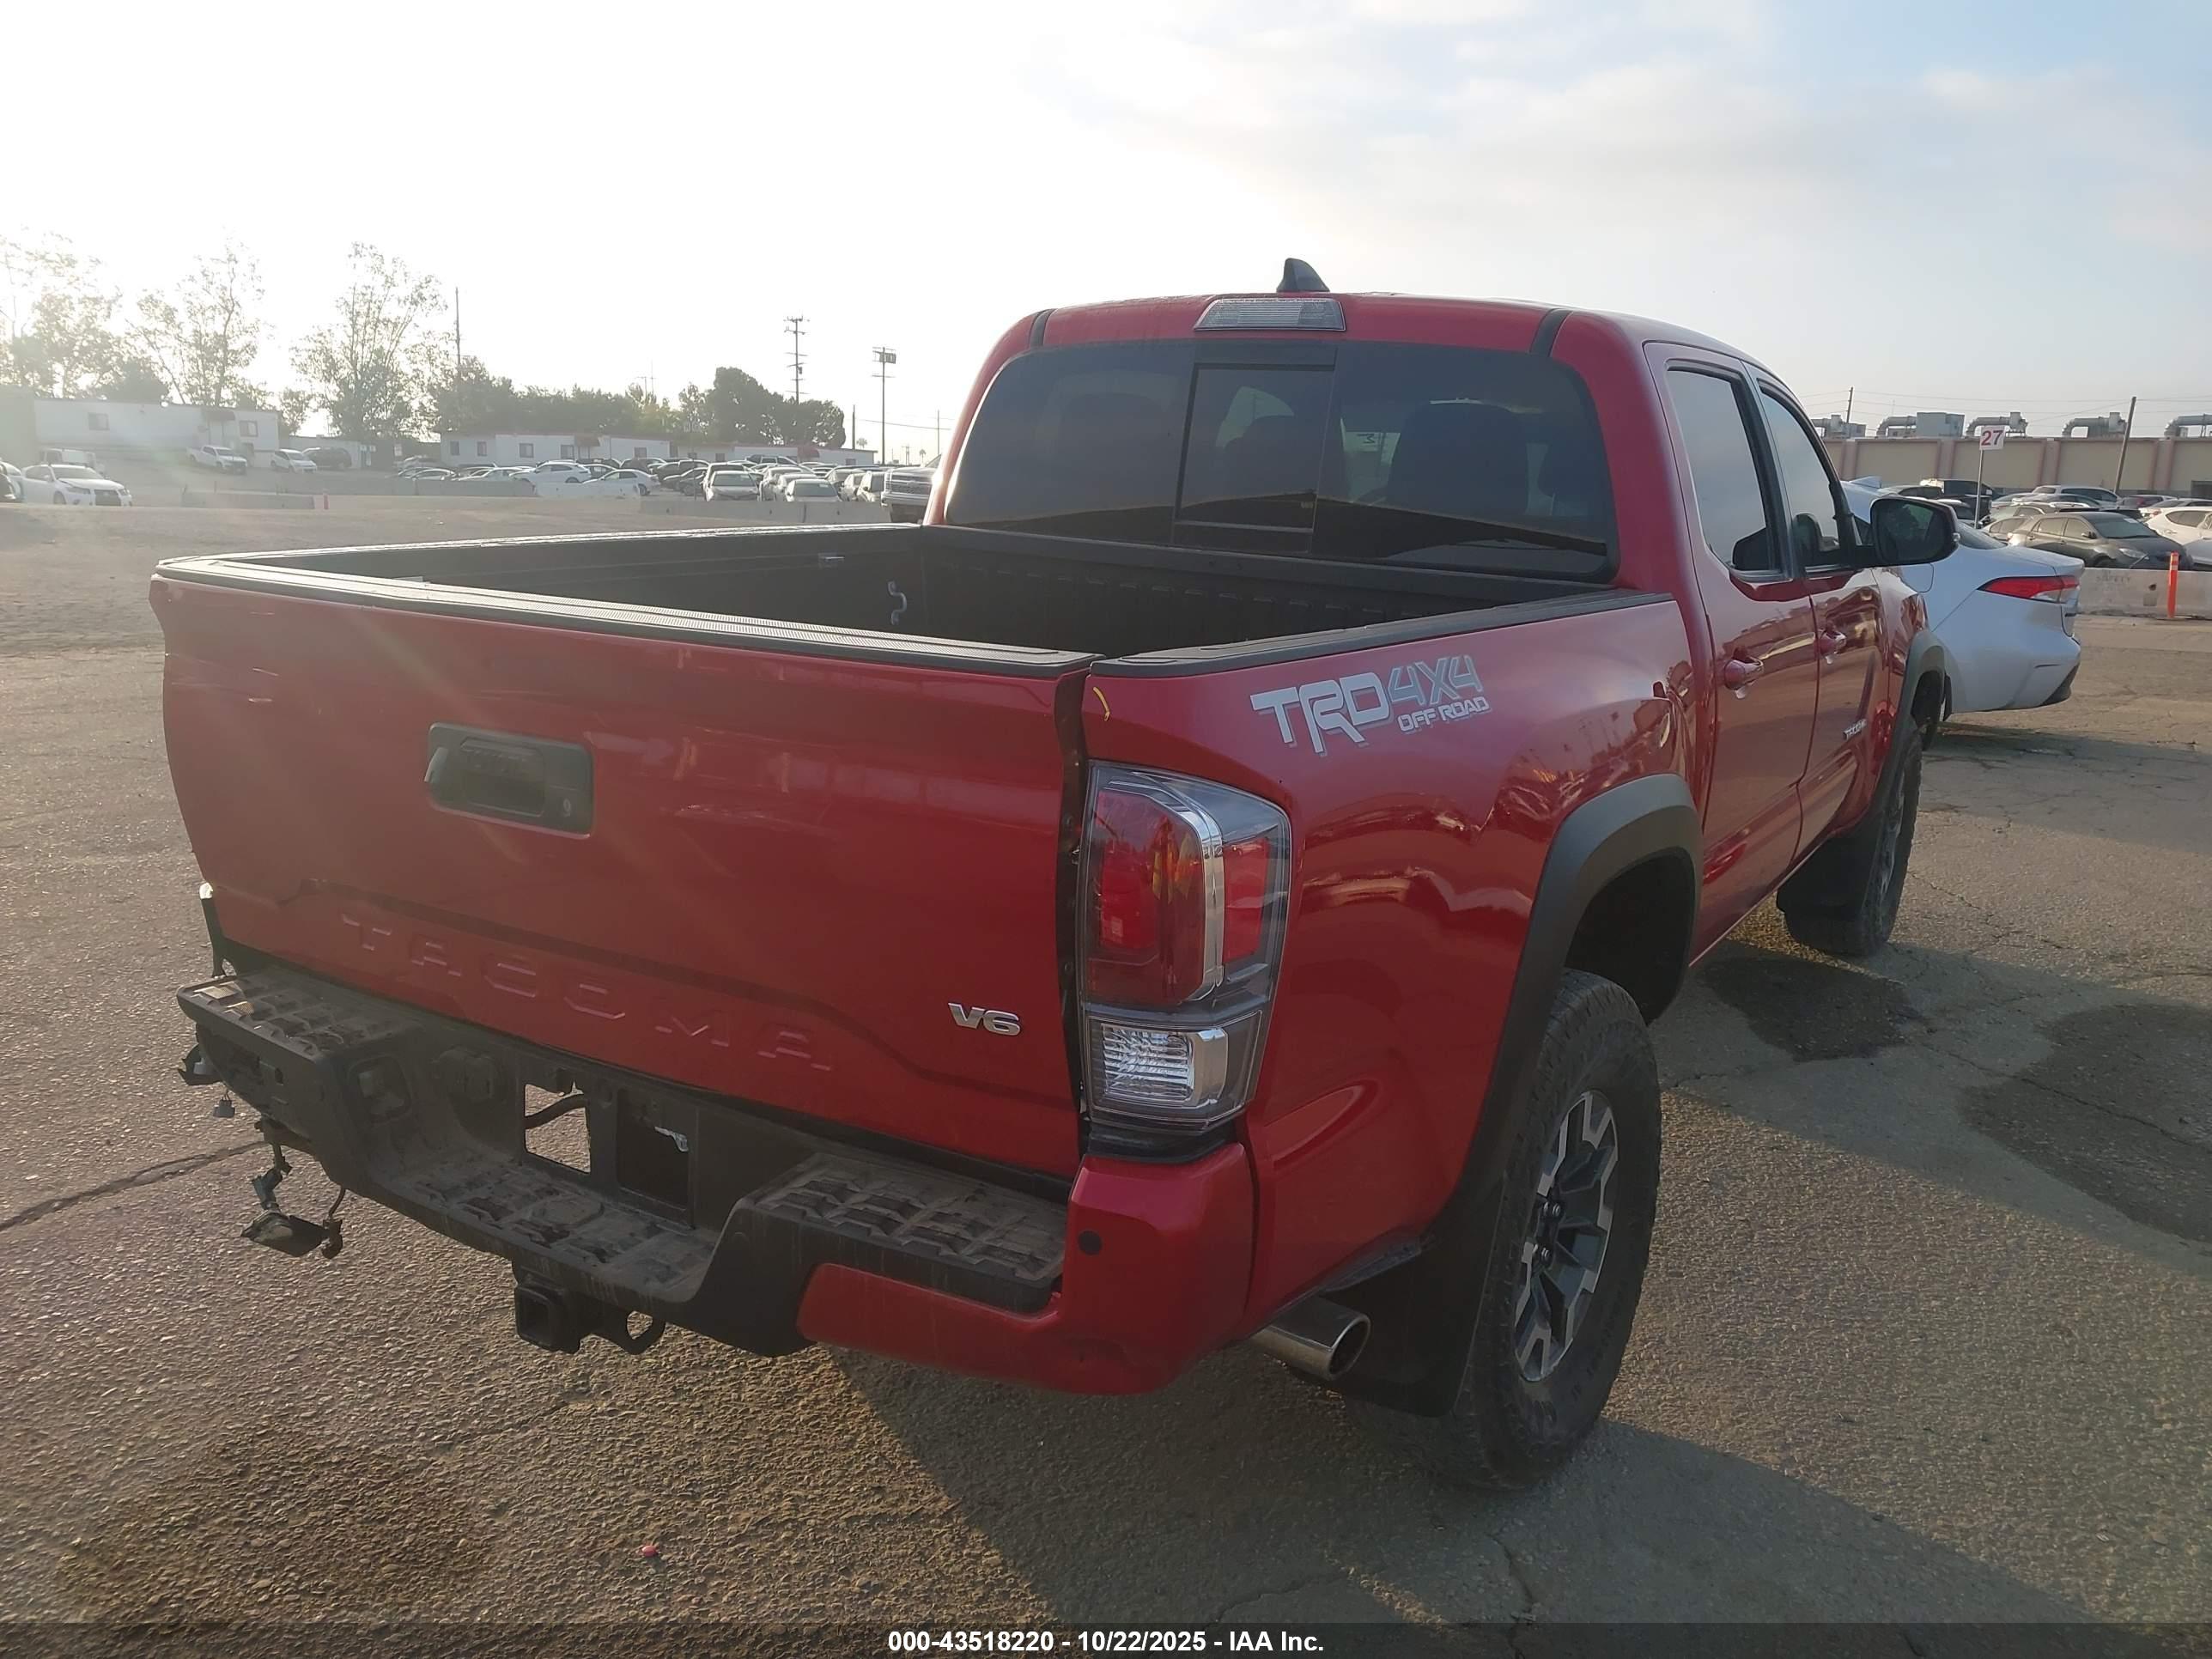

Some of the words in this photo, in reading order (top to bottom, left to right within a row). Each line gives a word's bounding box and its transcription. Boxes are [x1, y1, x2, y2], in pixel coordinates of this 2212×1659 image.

[1981, 430, 2003, 446] 27
[1250, 672, 1390, 754] TRD
[1397, 708, 1437, 732] OFF
[1440, 696, 1491, 722] ROAD
[340, 910, 831, 1071] TACOMA
[948, 1001, 1020, 1036] V6
